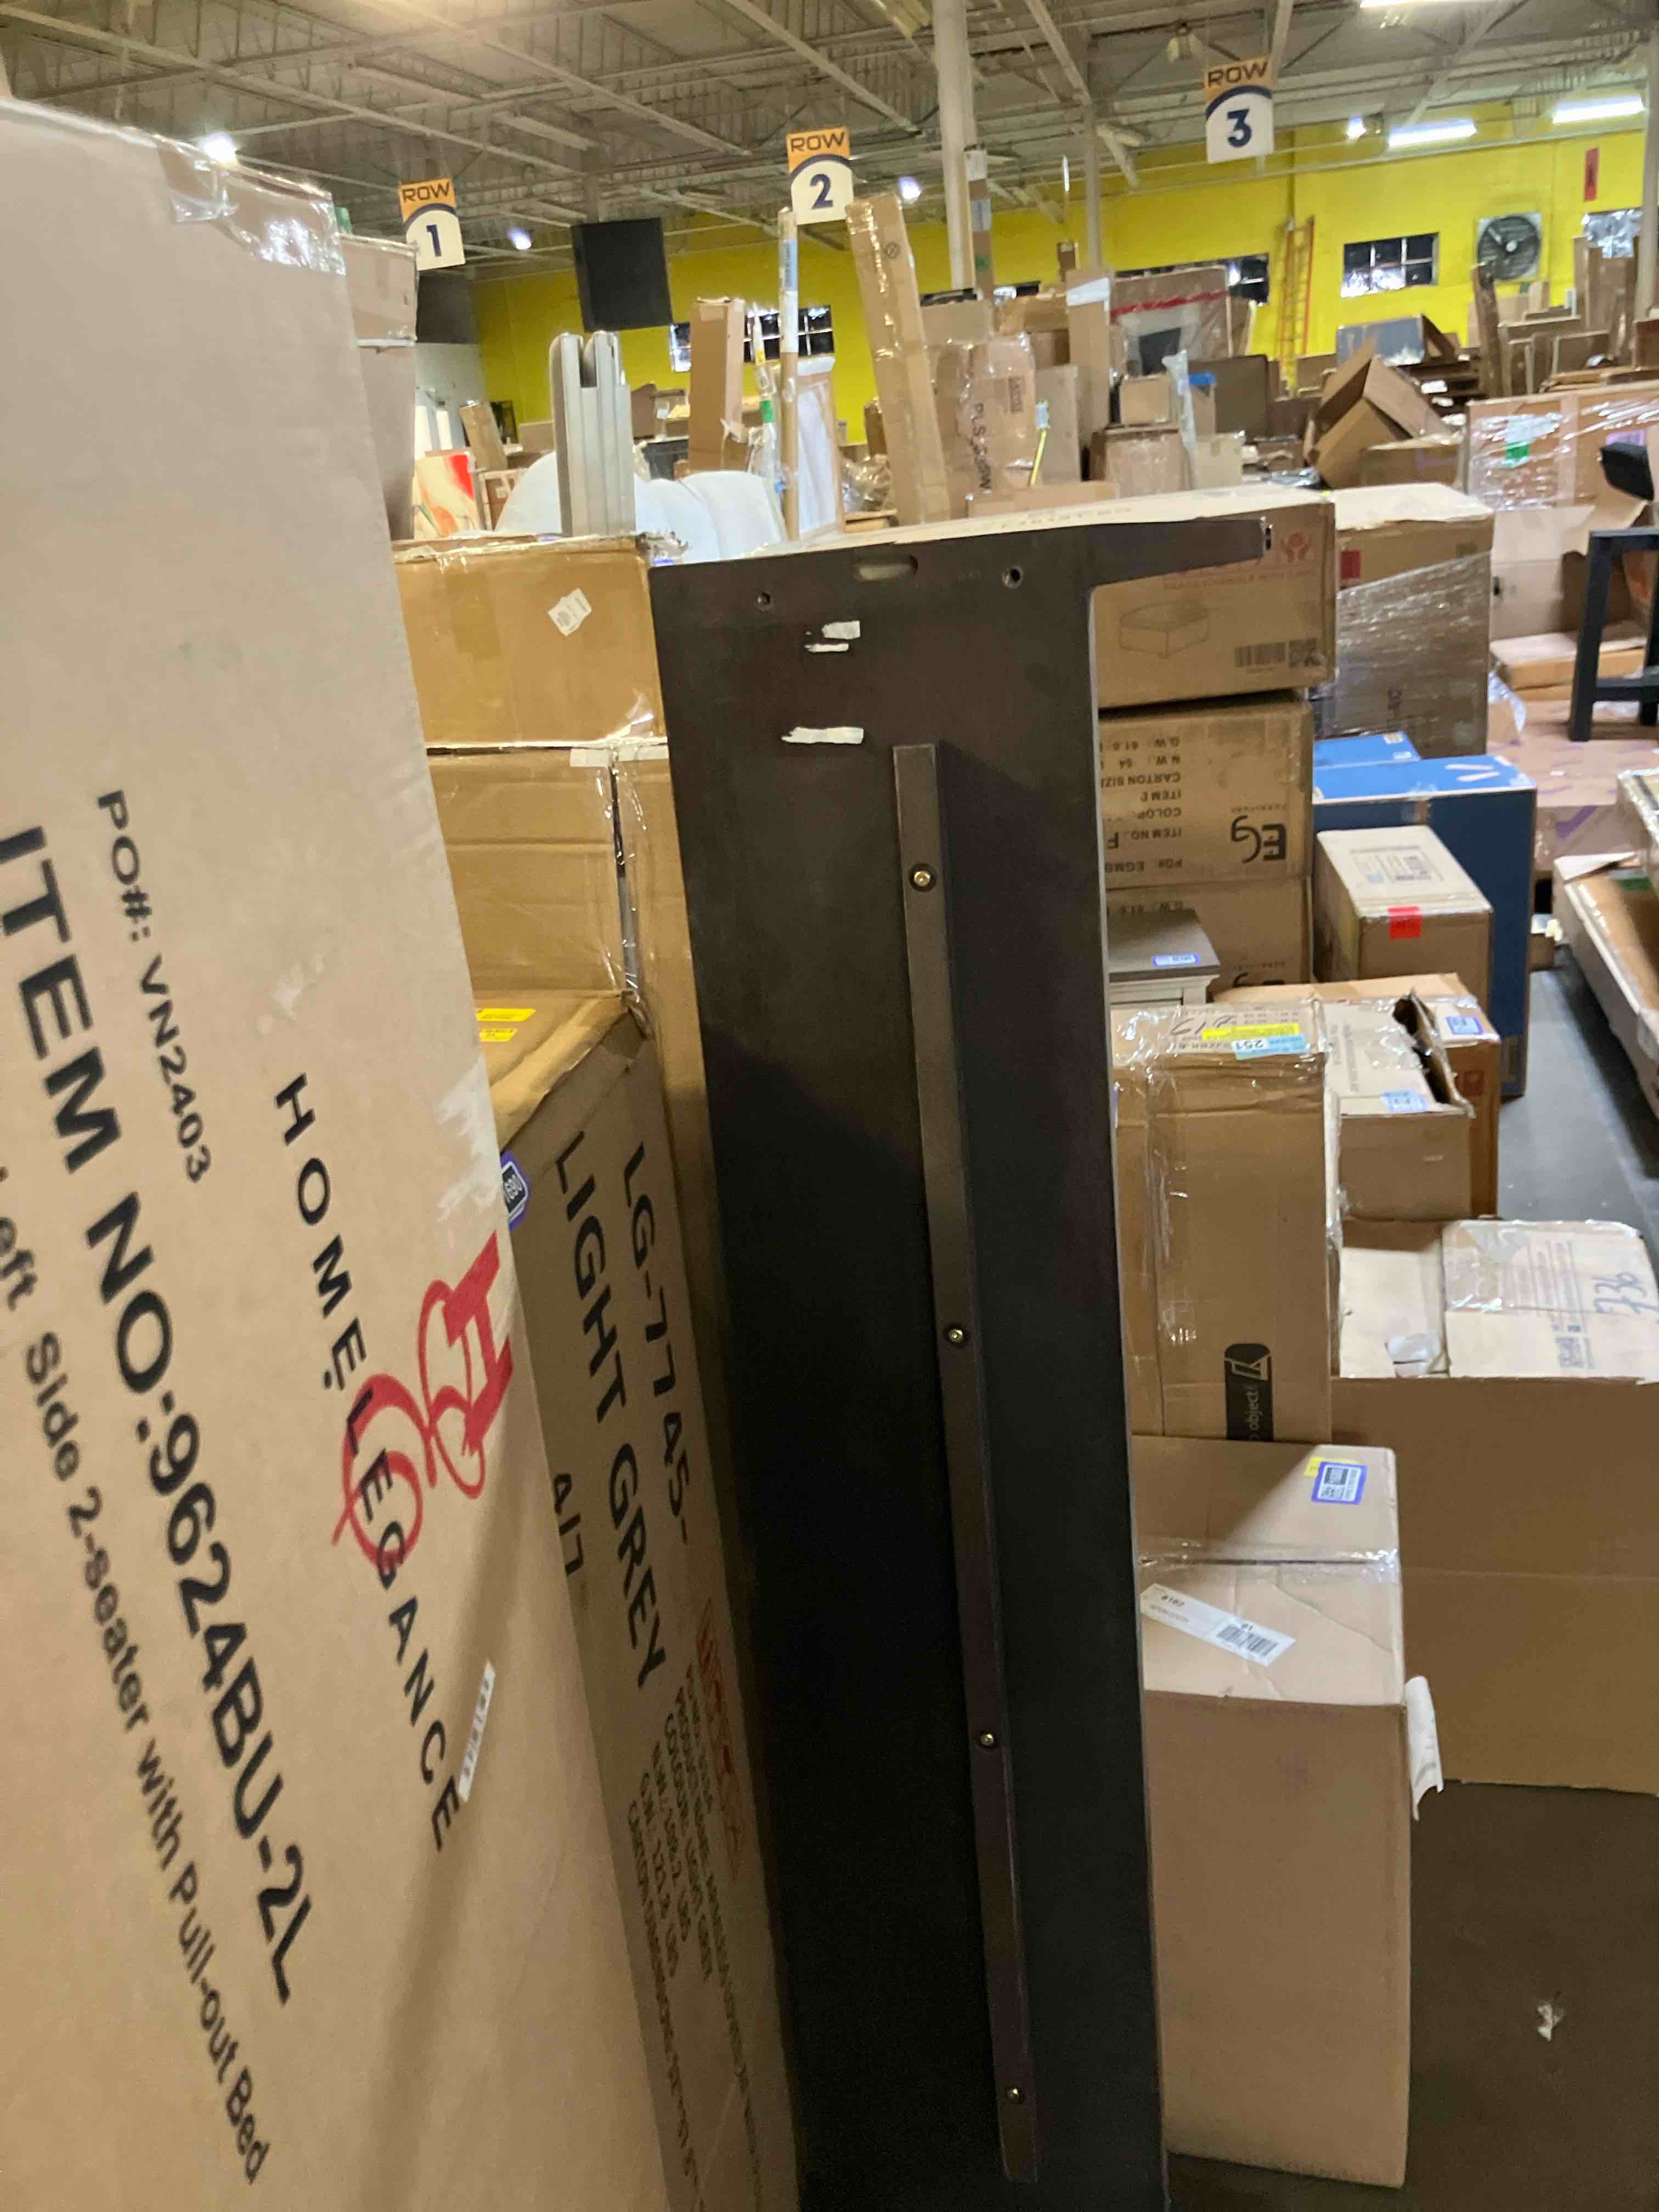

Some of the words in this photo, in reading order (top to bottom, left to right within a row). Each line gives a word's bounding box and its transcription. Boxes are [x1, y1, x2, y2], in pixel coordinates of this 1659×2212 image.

[1207, 60, 1269, 87] ROW
[790, 132, 846, 152] ROW
[1226, 109, 1252, 148] 3
[402, 182, 452, 203] ROW
[809, 173, 834, 210] 2
[426, 224, 443, 257] 1
[1128, 771, 1181, 786] CARTON
[0, 825, 123, 1175] ITEM
[97, 788, 153, 943] PO#:
[138, 952, 212, 1183] VN2403
[556, 1130, 627, 1423] LIGHT
[608, 1443, 667, 1689] GREY
[25, 1330, 81, 1483] Side
[67, 1485, 153, 1734] 2-seater
[136, 1737, 184, 1870] with
[167, 1860, 239, 2085] Pull-out
[224, 2064, 272, 2186] Bed
